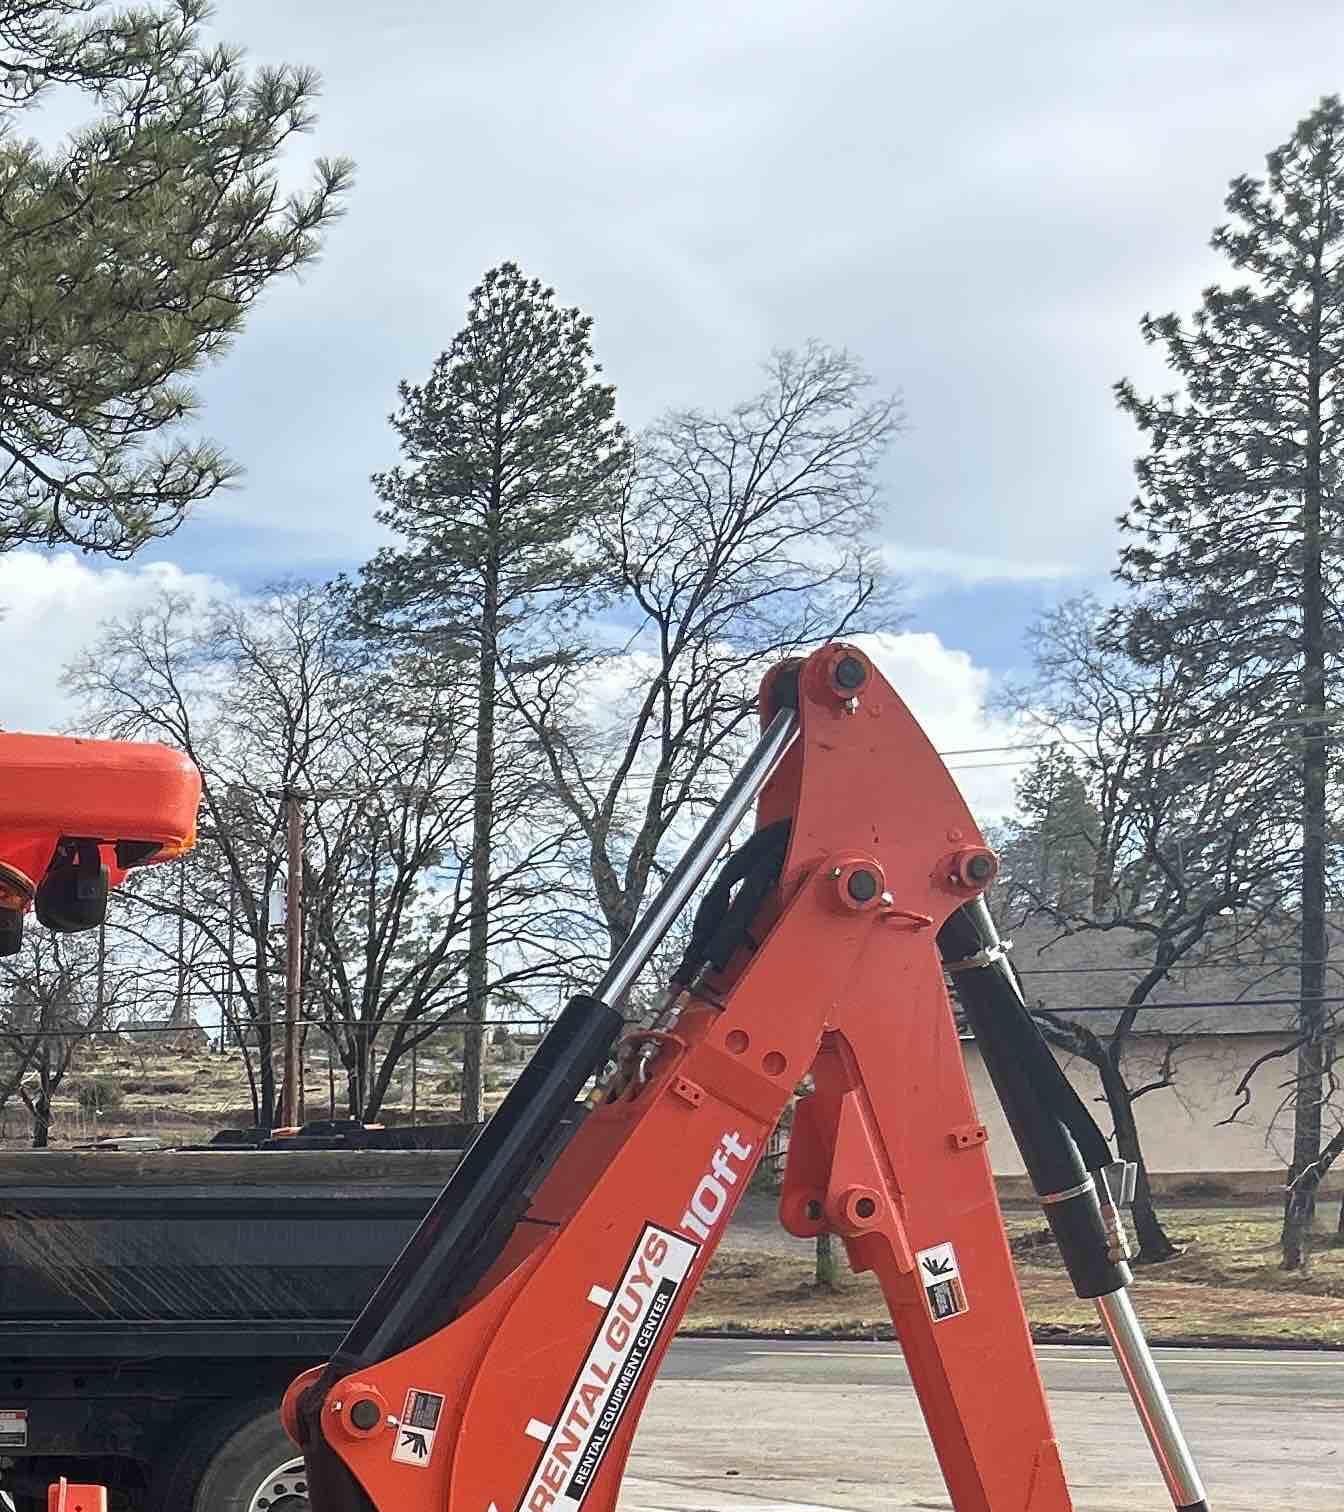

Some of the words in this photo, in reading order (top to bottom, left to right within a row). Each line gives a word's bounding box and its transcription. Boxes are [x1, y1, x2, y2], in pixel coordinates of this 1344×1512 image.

[679, 1130, 752, 1241] 10ft
[605, 1233, 669, 1353] GUYS
[576, 1432, 606, 1486] RENTAL
[600, 1351, 644, 1432] EQUIPMENT
[637, 1292, 670, 1348] CENTER
